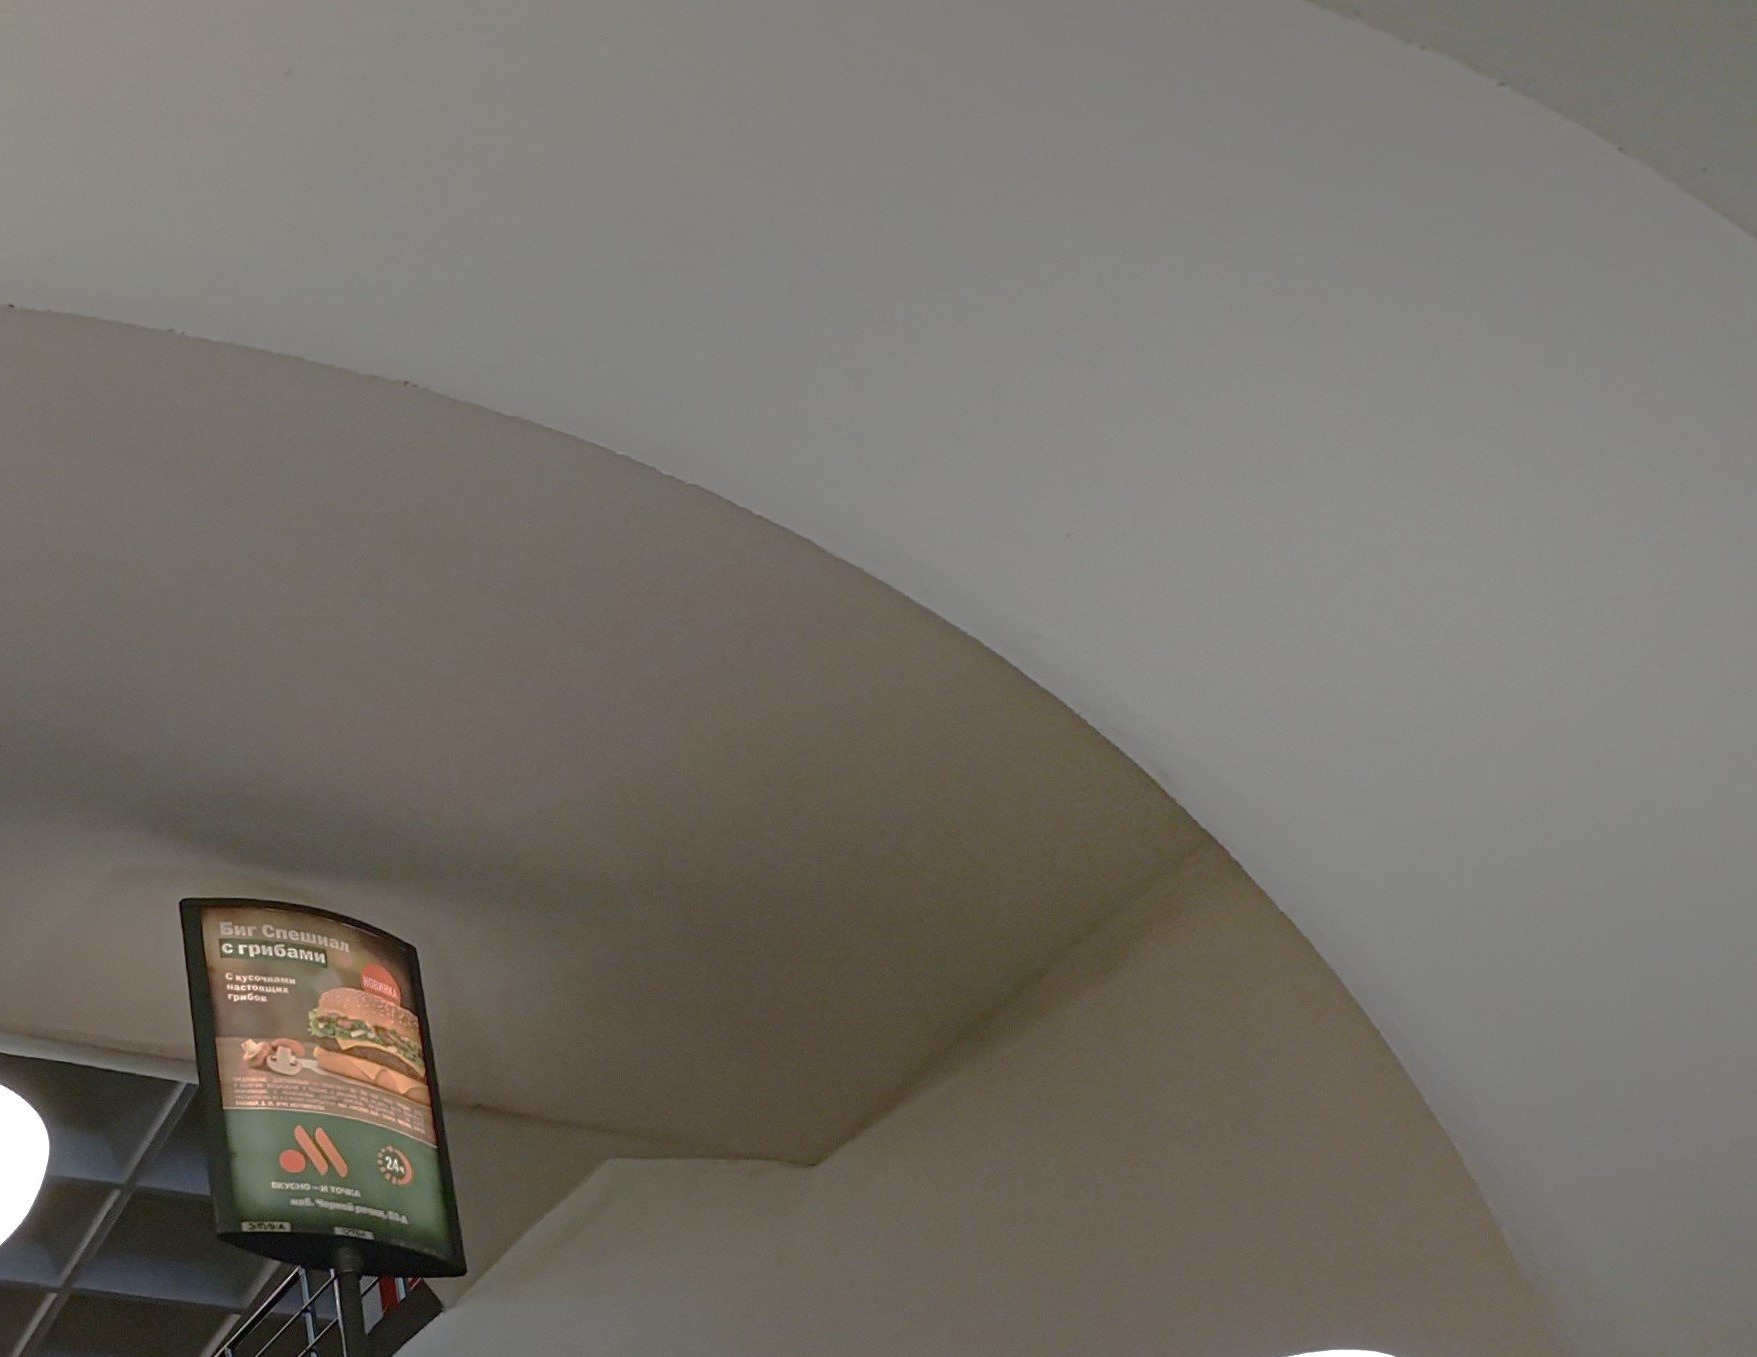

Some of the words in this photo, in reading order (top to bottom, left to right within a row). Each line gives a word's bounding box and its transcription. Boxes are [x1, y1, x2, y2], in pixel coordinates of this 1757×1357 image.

[219, 921, 257, 937] Биг
[261, 923, 350, 953] Спешиал
[221, 943, 233, 954] с
[238, 943, 327, 965] грибами
